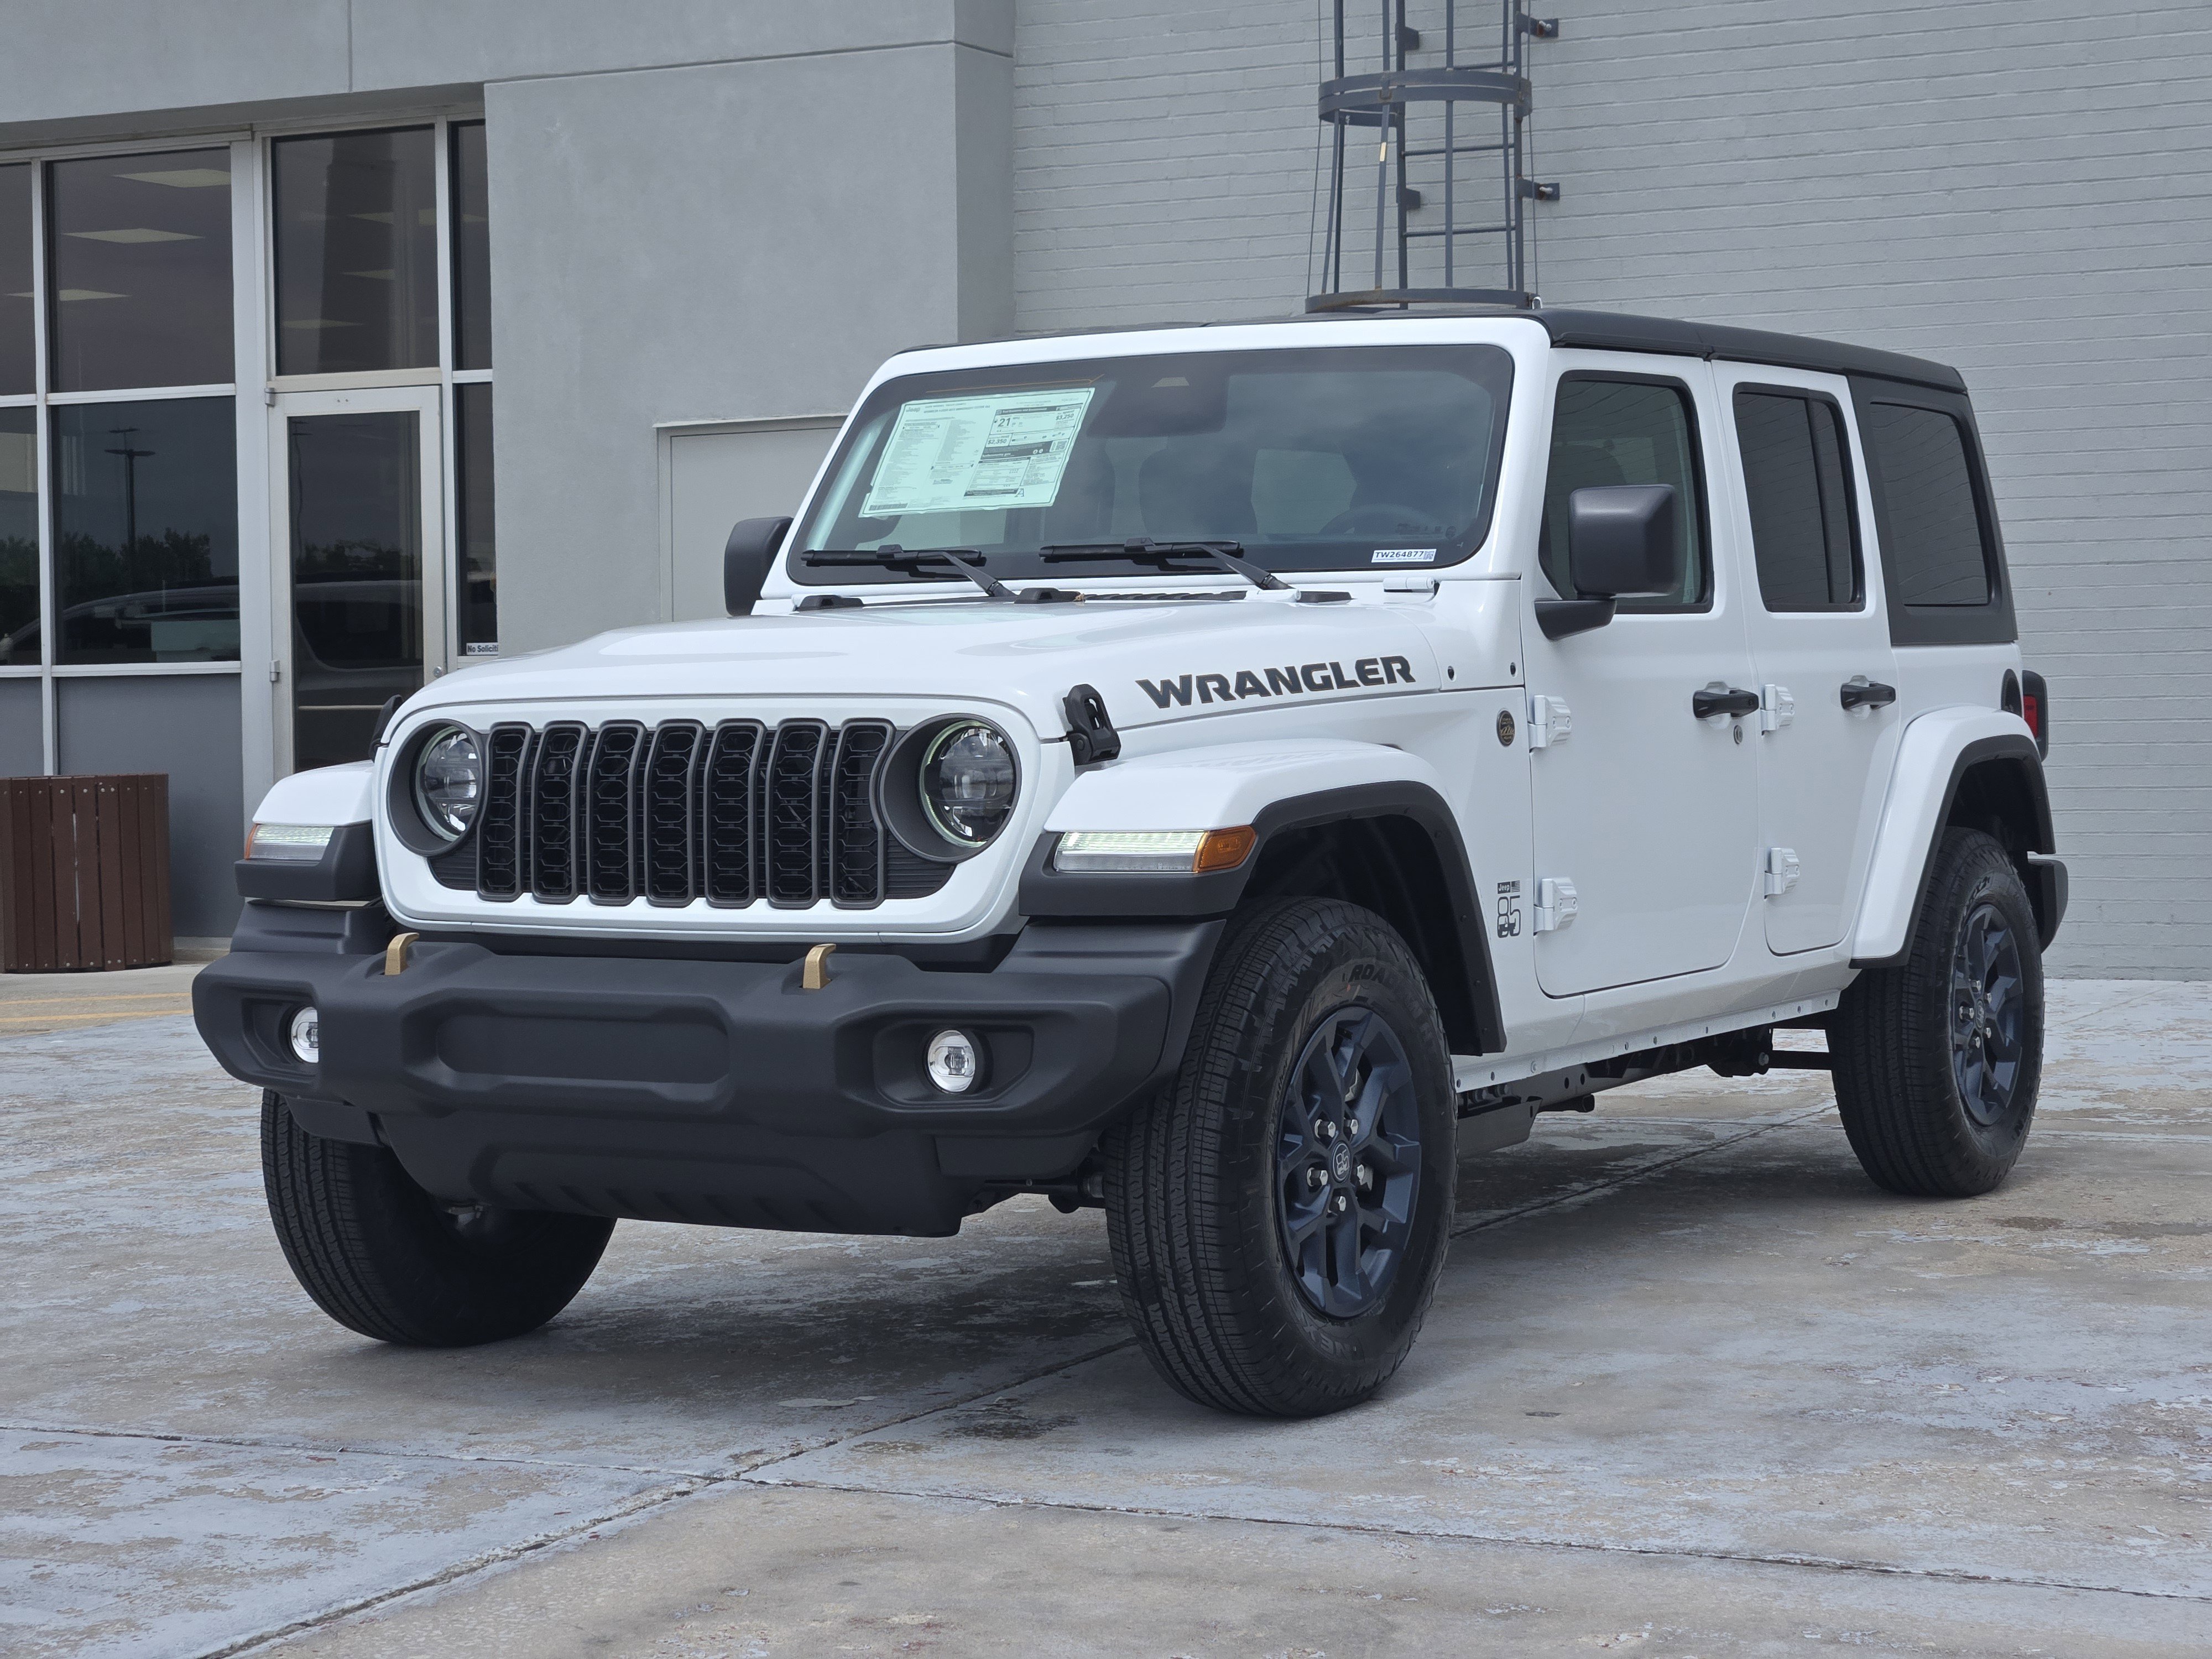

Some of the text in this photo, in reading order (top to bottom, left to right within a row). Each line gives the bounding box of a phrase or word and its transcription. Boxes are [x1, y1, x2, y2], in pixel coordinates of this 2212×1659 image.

[998, 418, 1011, 427] 21
[1135, 655, 1416, 708] WRANGLER
[1498, 883, 1510, 891] Jeep
[1497, 895, 1521, 938] 85
[1335, 1149, 1350, 1175] 85
